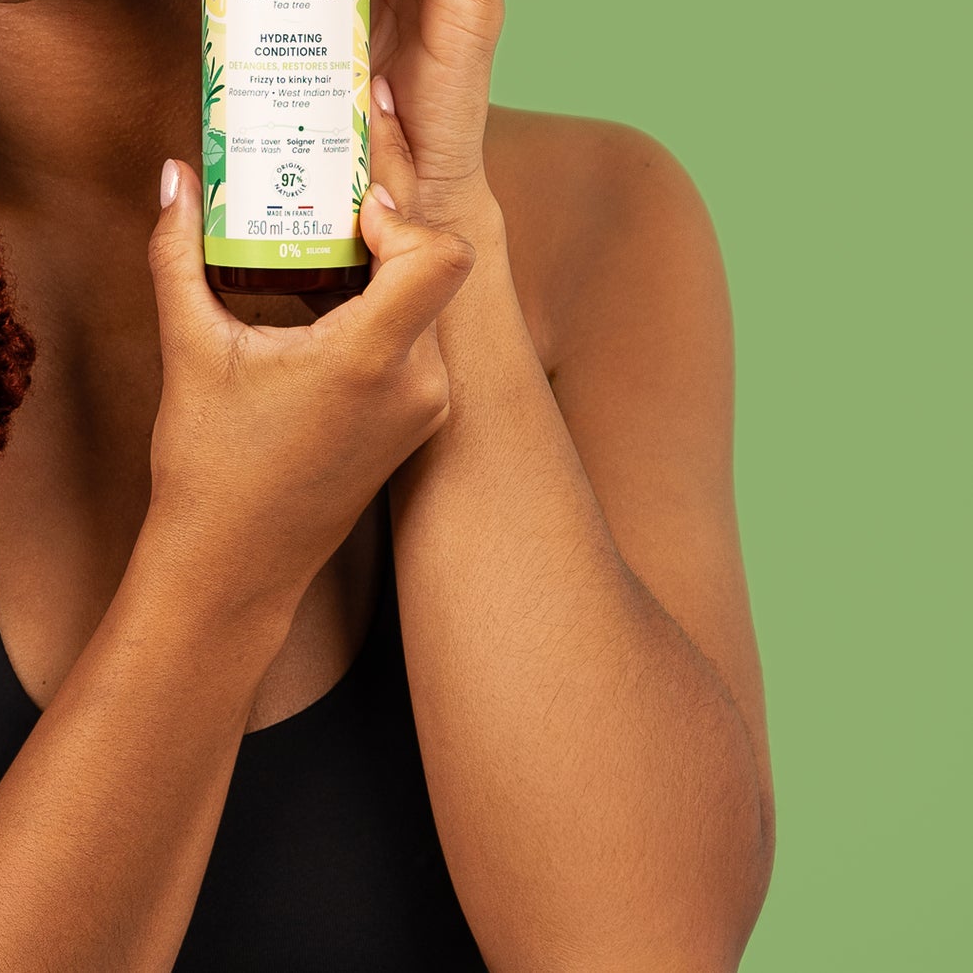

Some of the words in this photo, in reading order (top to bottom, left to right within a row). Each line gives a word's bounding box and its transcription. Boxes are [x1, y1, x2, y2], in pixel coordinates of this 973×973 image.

[272, 1, 290, 10] Tea
[292, 1, 311, 10] tree
[260, 33, 323, 43] HYDRATING
[254, 47, 328, 57] CONDITIONER
[228, 61, 280, 71] DETANGLES,
[282, 61, 328, 71] RESTORES
[329, 60, 351, 70] SHINE
[250, 75, 274, 85] Frizzy
[276, 76, 286, 84] to
[288, 75, 313, 86] kinky
[315, 75, 332, 84] hair
[228, 88, 270, 99] Rosemary
[278, 89, 301, 97] West
[303, 88, 330, 97] Indian
[332, 88, 347, 98] bay
[272, 100, 290, 108] Tea
[292, 100, 311, 109] tree
[232, 137, 254, 145] Exfolier
[261, 137, 281, 146] Laver
[286, 137, 316, 147] Soigner
[321, 137, 350, 145] Entretenir
[230, 145, 257, 153] Exfoliate
[261, 146, 281, 154] Wash
[292, 146, 311, 154] Care
[323, 145, 350, 154] Maintain
[276, 162, 306, 174] ORIGINE
[281, 173, 303, 187] 97%
[274, 183, 307, 198] NATURELLE
[247, 220, 267, 235] 250
[269, 220, 283, 235] ml
[292, 220, 311, 235] 8.5
[279, 243, 301, 258] 0%
